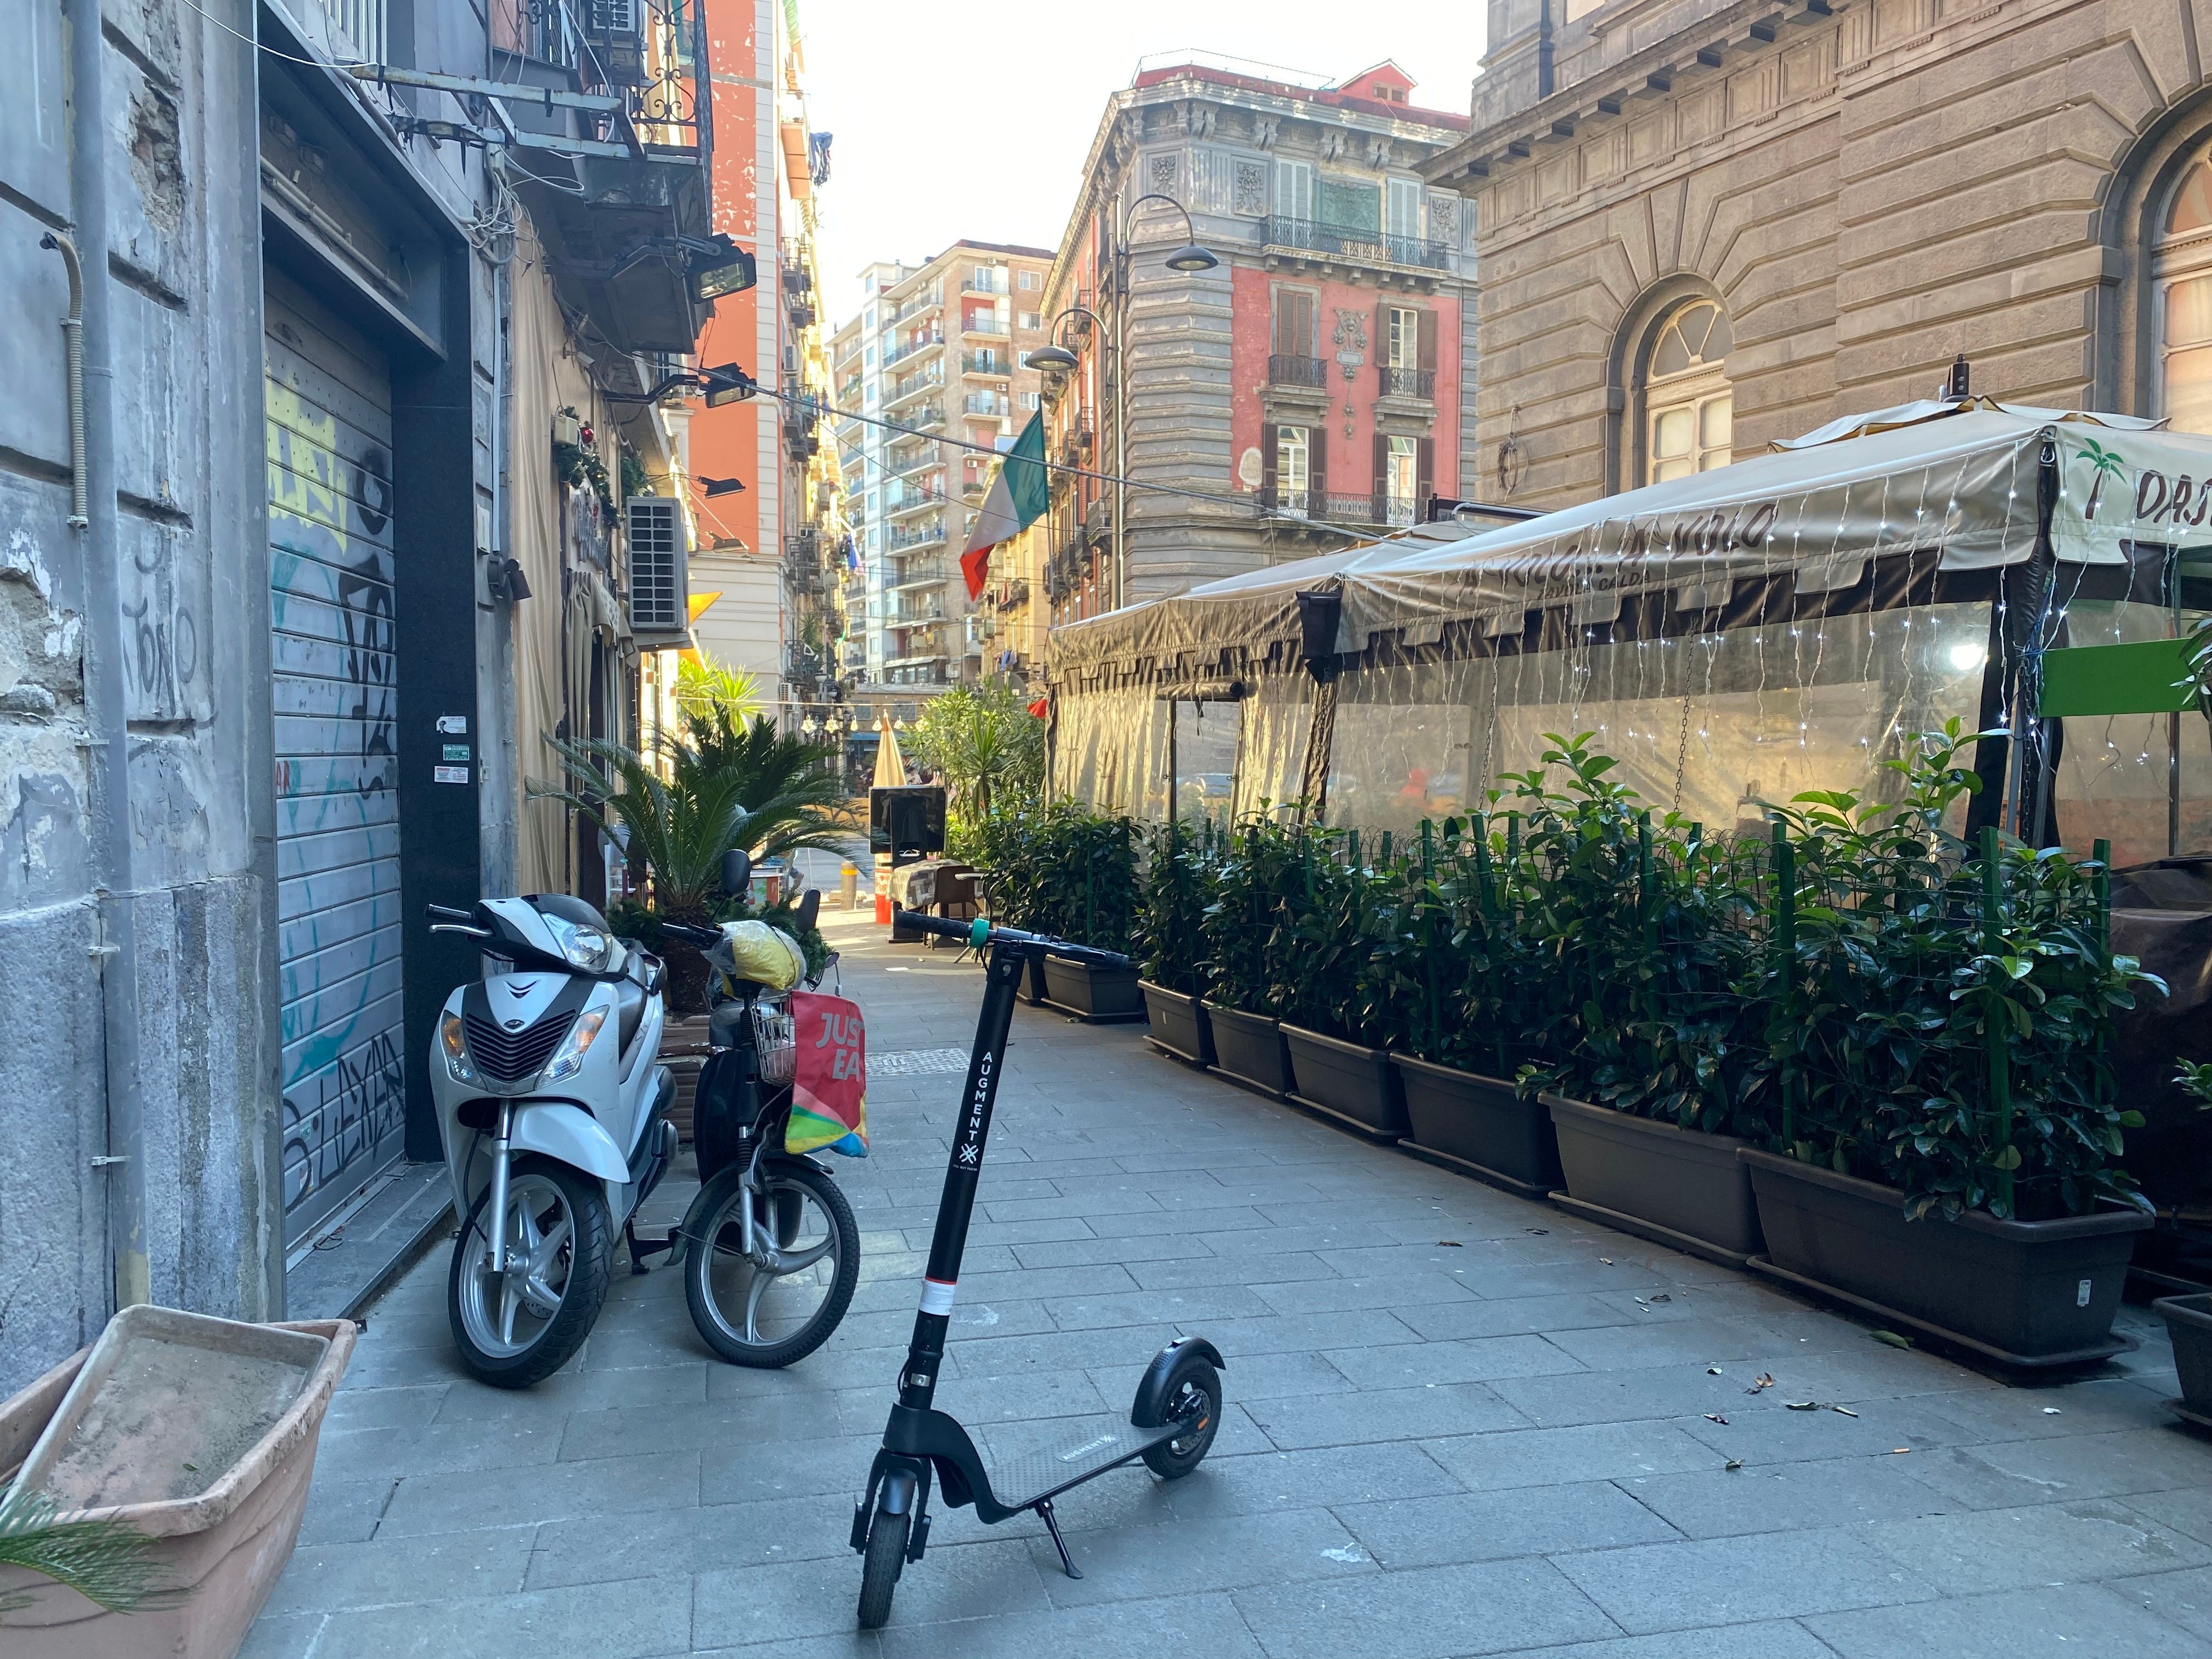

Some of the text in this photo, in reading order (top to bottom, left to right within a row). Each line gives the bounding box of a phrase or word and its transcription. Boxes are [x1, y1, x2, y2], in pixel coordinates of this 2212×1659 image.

[2136, 470, 2212, 527] DAS
[1672, 503, 1779, 560] VOLO
[1538, 570, 1650, 600] TAVOLA CALDA
[969, 1051, 993, 1141] AUGMENT
[1062, 1440, 1103, 1461] AUGMENT
